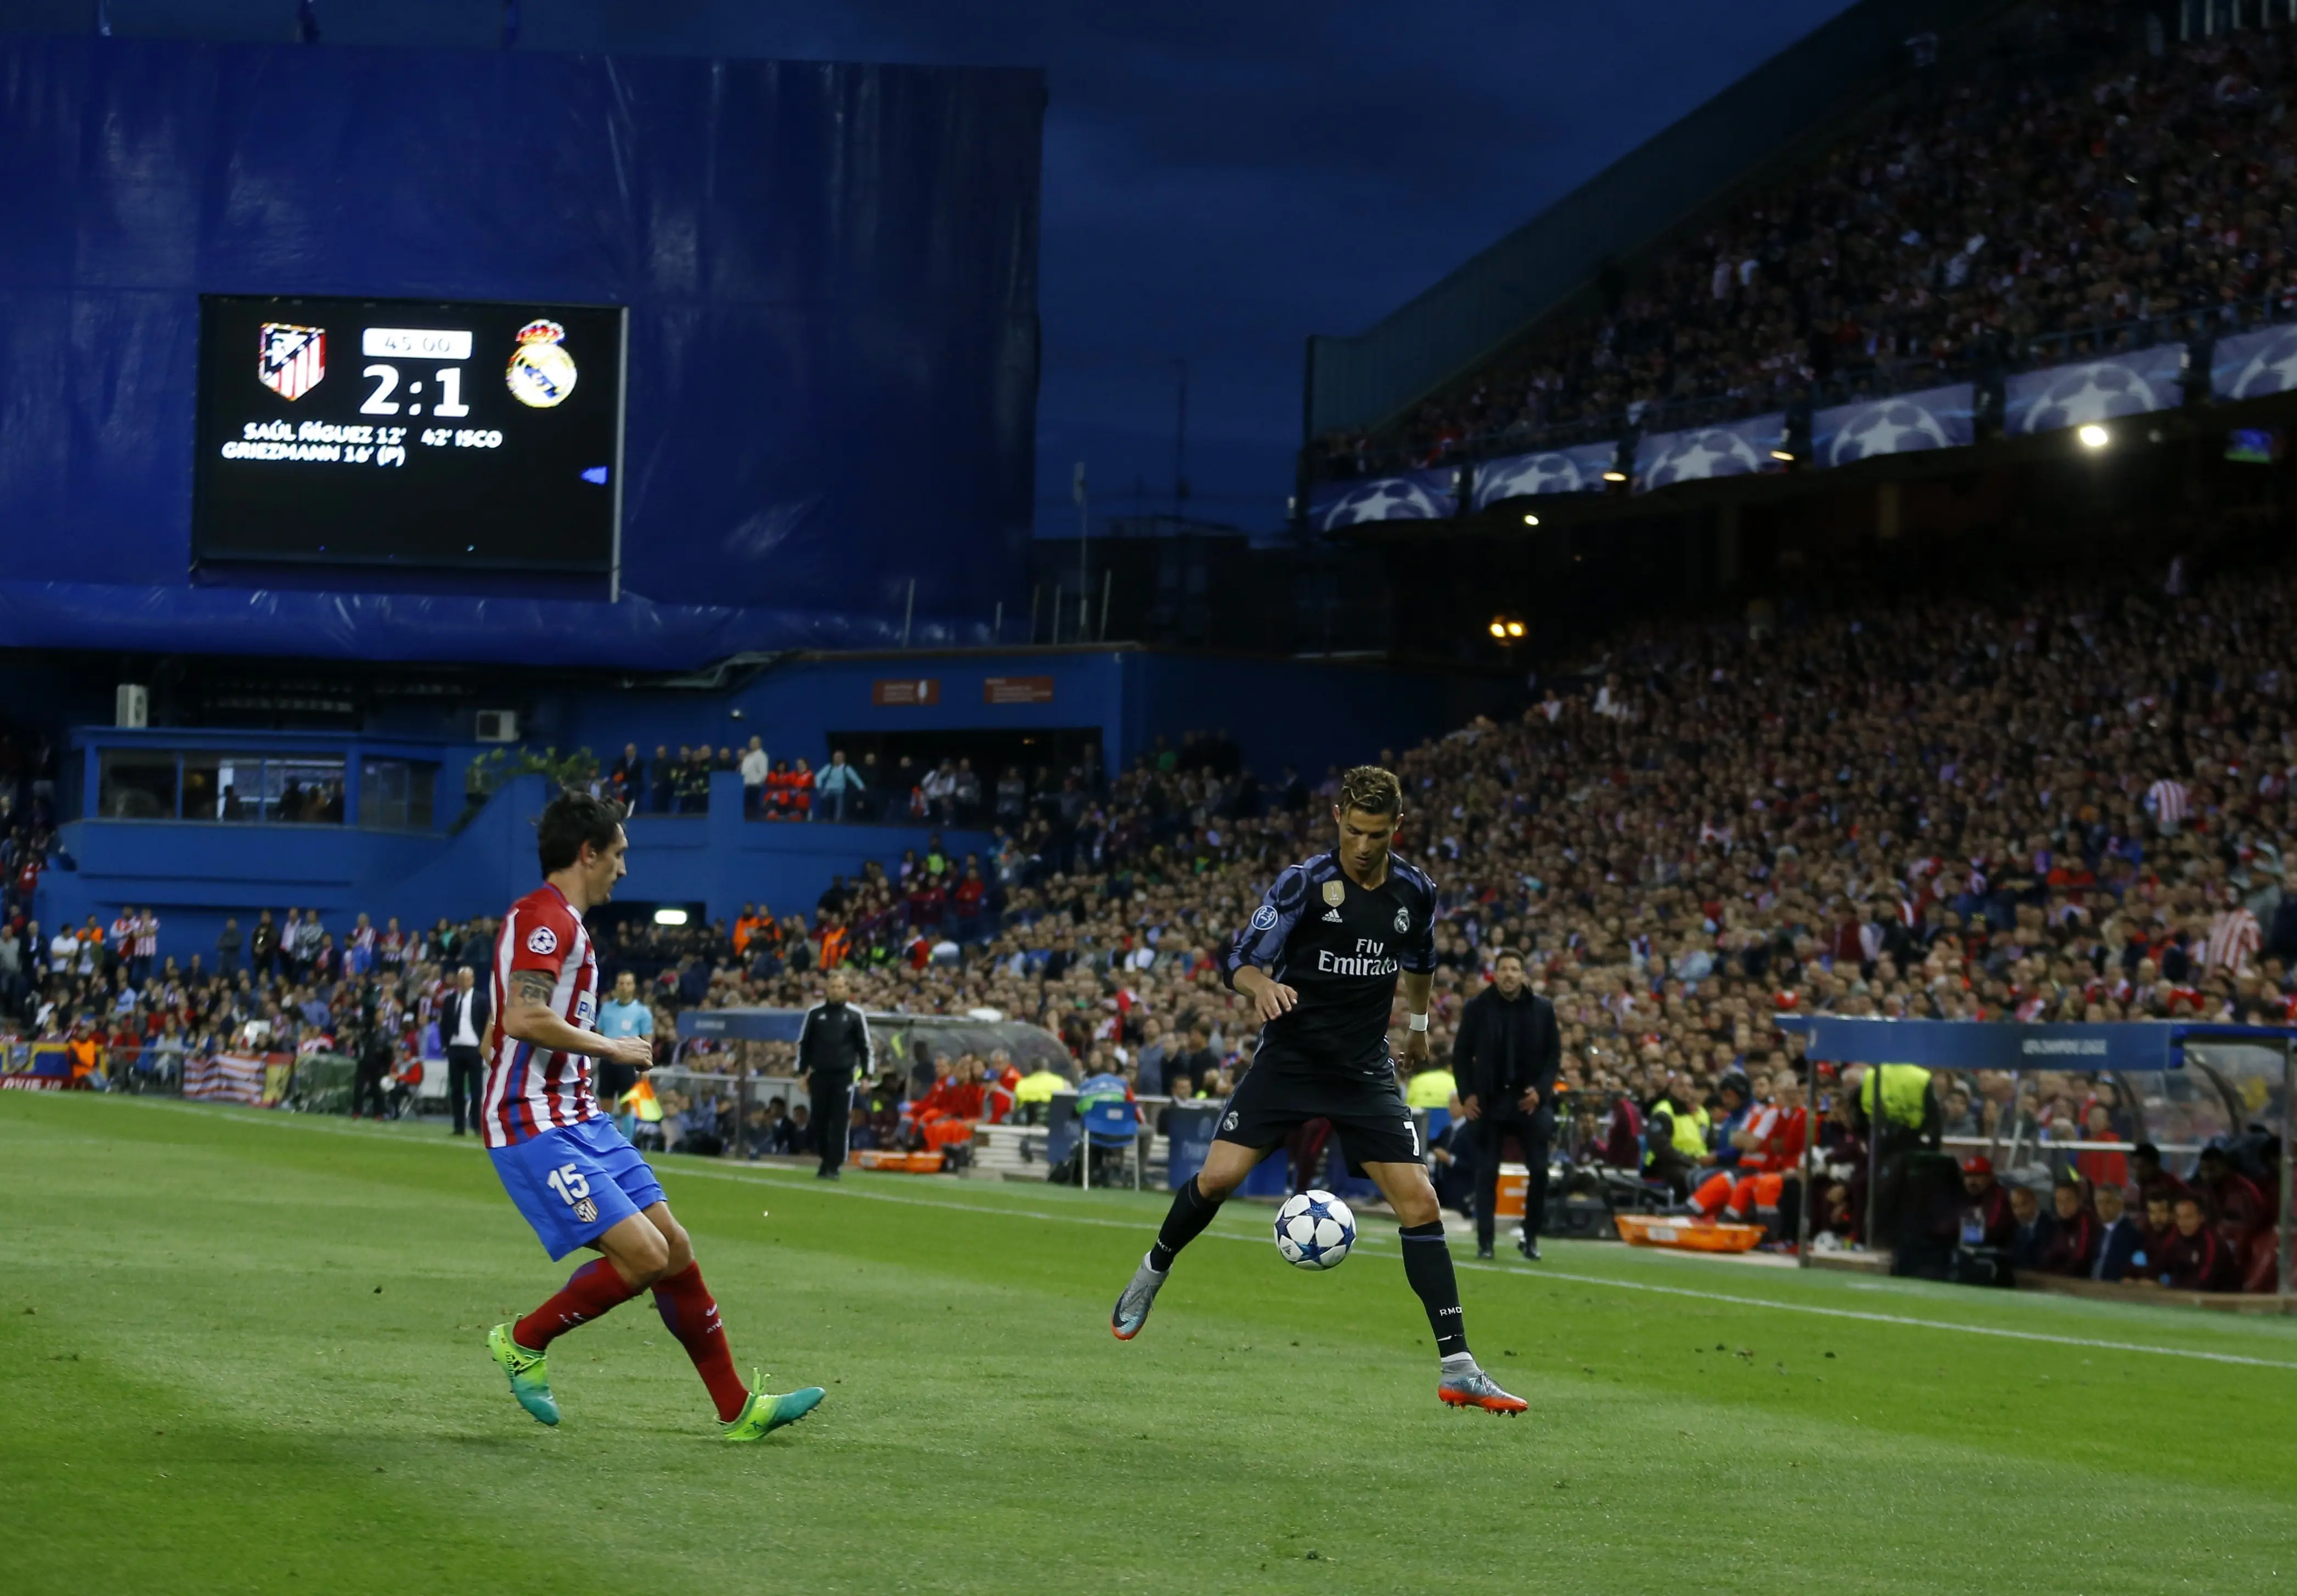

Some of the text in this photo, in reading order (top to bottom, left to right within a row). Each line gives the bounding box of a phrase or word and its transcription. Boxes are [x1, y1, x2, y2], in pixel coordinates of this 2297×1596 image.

[244, 419, 297, 441] SAÚL
[455, 430, 503, 448] ISCO
[221, 441, 341, 462] GRIEZMANN
[1356, 938, 1384, 956] Fly
[1318, 950, 1398, 976] Emirates
[1403, 1121, 1420, 1156] 7
[547, 1163, 590, 1205] 15
